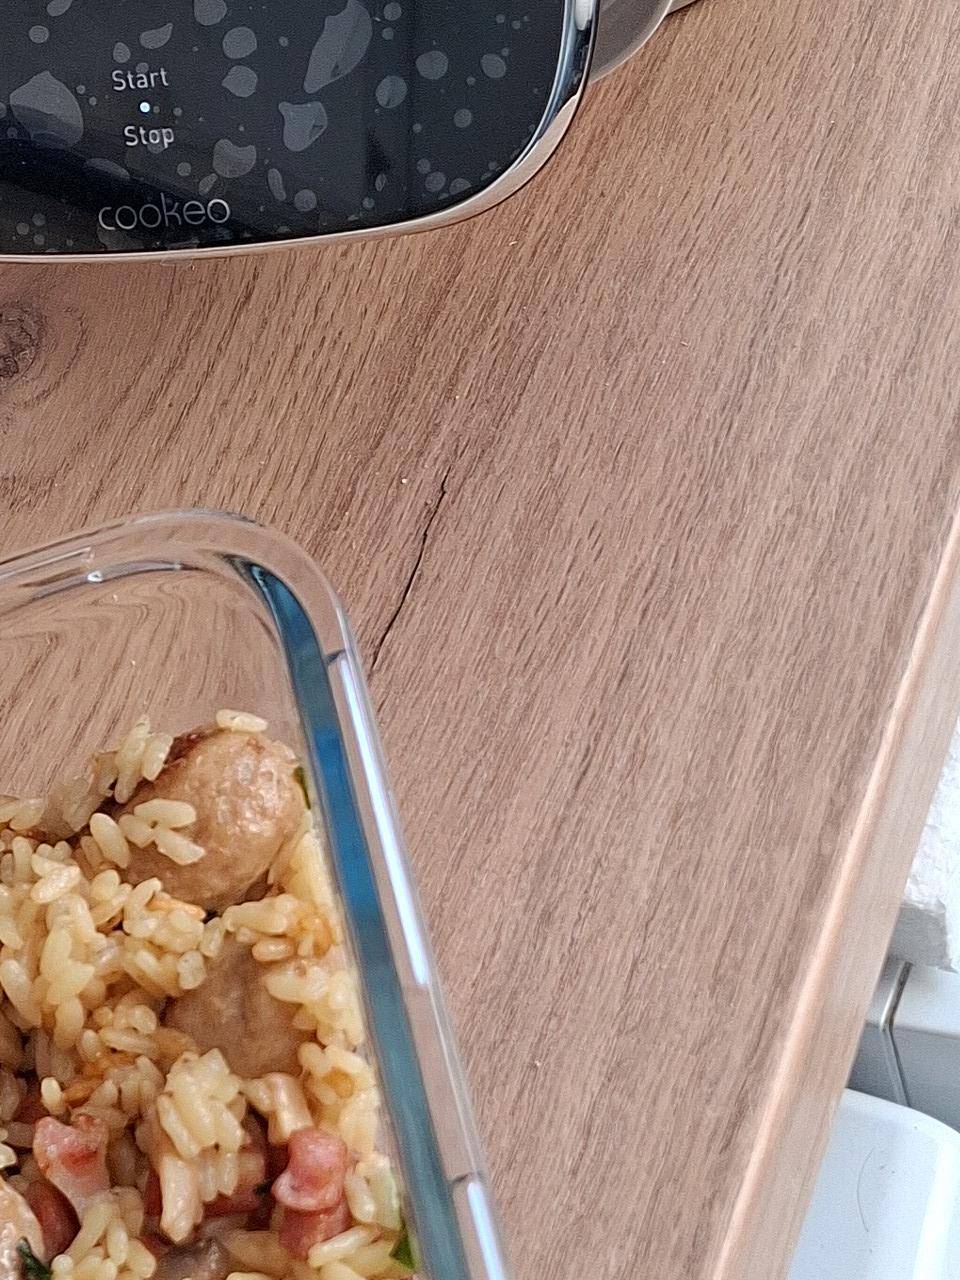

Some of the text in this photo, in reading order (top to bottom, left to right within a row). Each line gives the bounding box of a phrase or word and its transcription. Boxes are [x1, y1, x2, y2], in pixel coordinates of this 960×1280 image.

[112, 67, 169, 91] Start
[123, 124, 175, 148] Stop
[98, 192, 230, 231] cookeo
